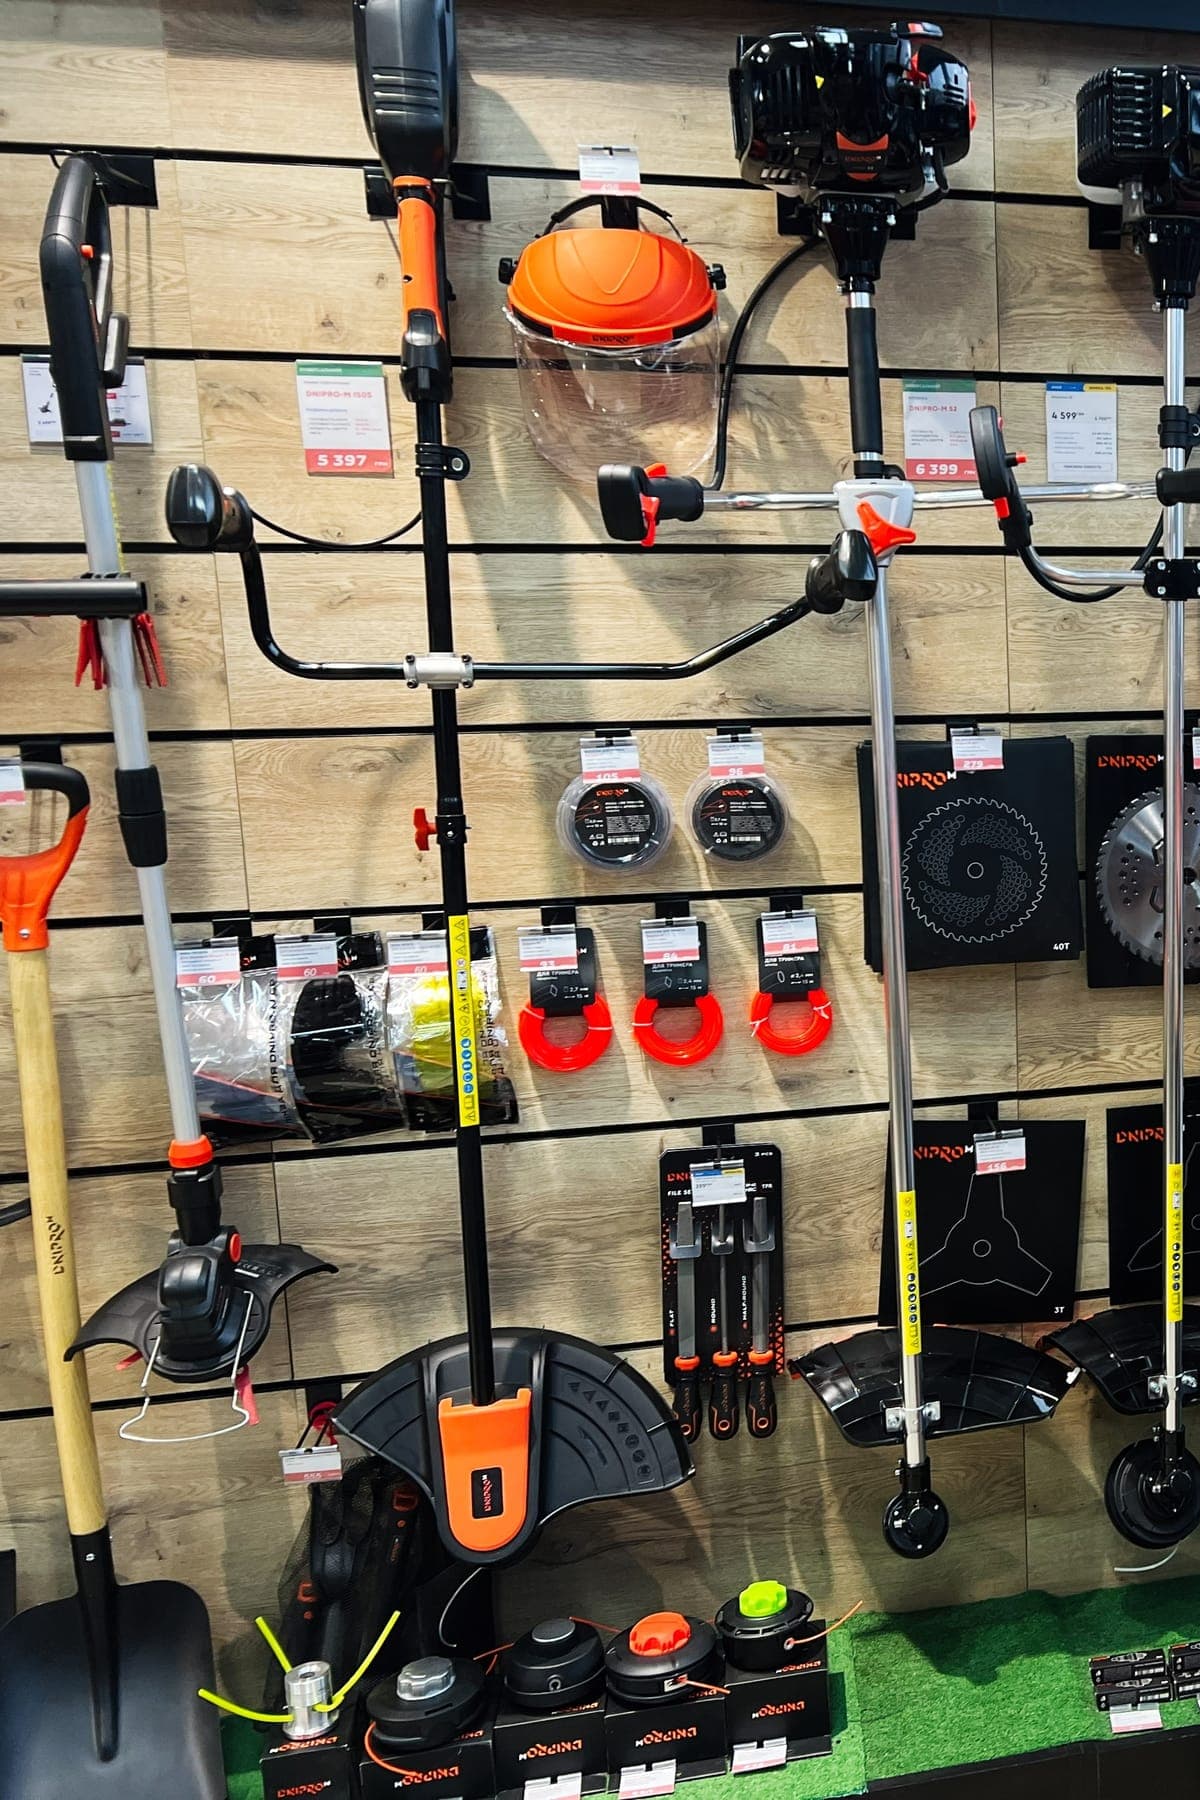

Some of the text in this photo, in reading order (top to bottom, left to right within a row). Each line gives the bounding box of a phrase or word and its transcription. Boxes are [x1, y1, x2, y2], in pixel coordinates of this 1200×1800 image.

[1051, 412, 1078, 420] 4 599
[317, 455, 367, 467] 5 397
[915, 464, 958, 475] 6 399
[1053, 942, 1071, 950] 40T
[303, 967, 318, 977] 60
[1053, 1306, 1065, 1314] 3T
